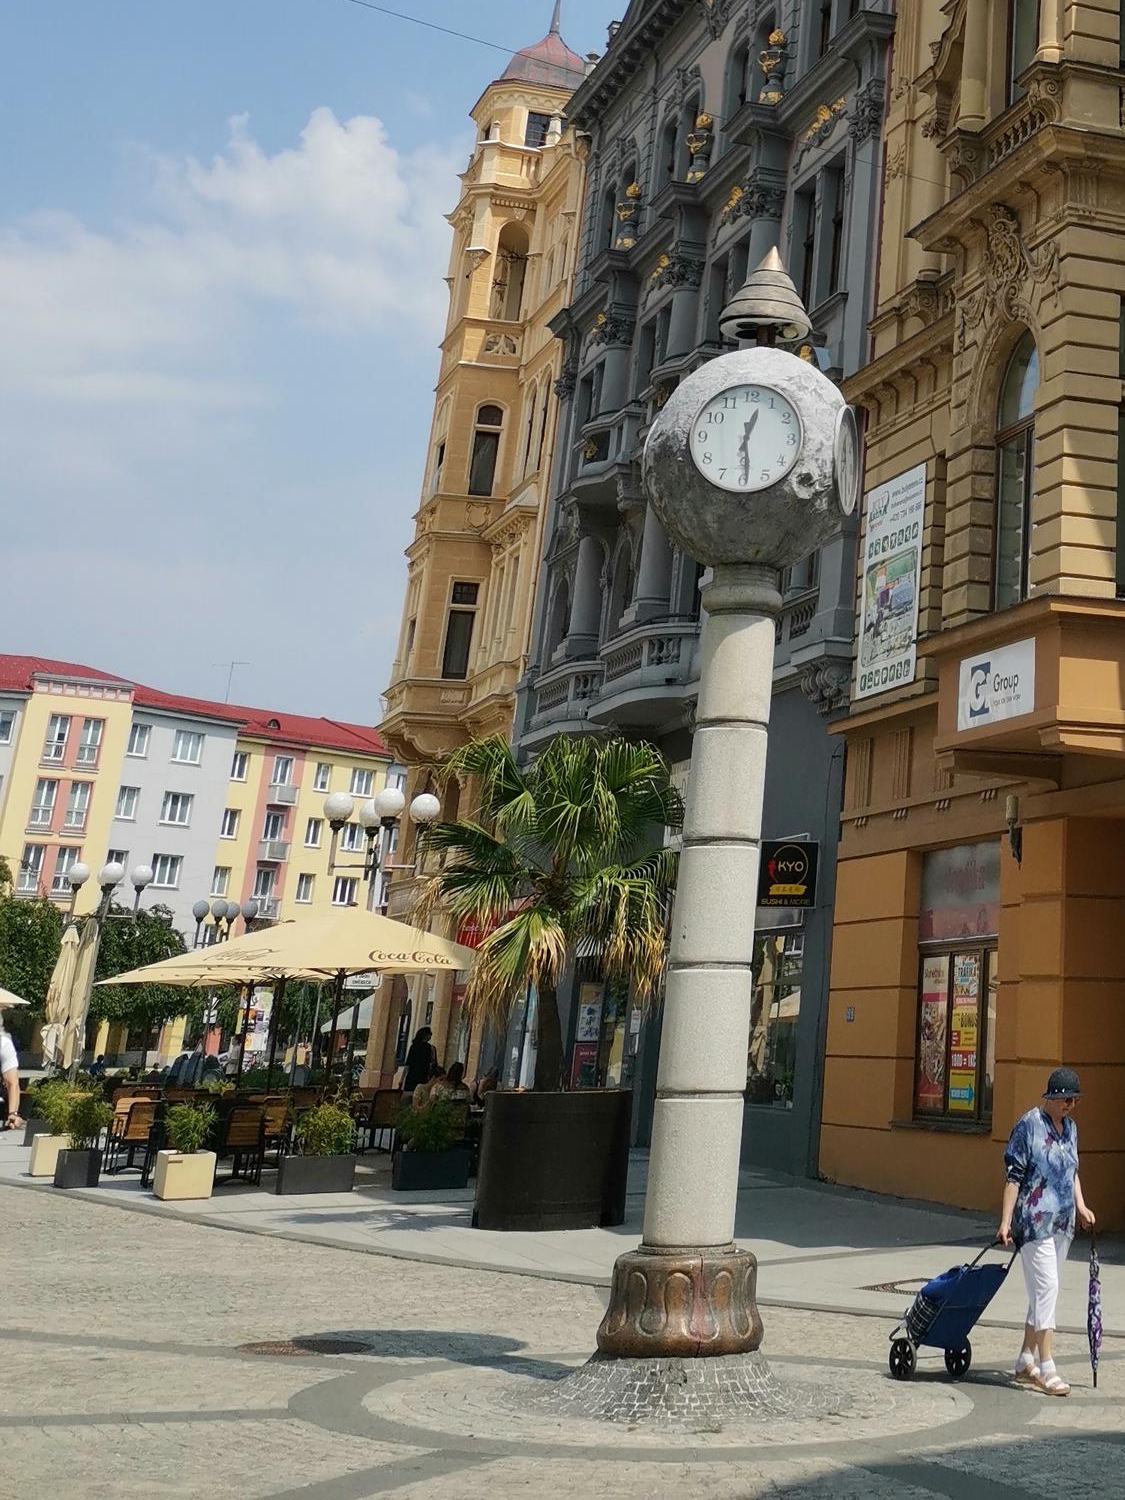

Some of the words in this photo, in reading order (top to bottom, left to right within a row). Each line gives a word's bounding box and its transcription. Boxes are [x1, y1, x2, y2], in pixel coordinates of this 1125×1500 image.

[744, 391, 760, 403] 12
[722, 397, 737, 410] 11
[768, 398, 776, 410] 1
[706, 412, 724, 424] 10
[782, 412, 791, 424] 2
[698, 430, 708, 443] 9
[786, 433, 796, 446] 3
[702, 452, 712, 464] 8
[777, 455, 786, 467] 4
[718, 468, 728, 480] 7
[760, 469, 770, 481] 5
[738, 475, 748, 486] 6
[993, 673, 1019, 693] Group
[778, 861, 804, 872] KYO
[368, 950, 452, 965] Coca-Cola
